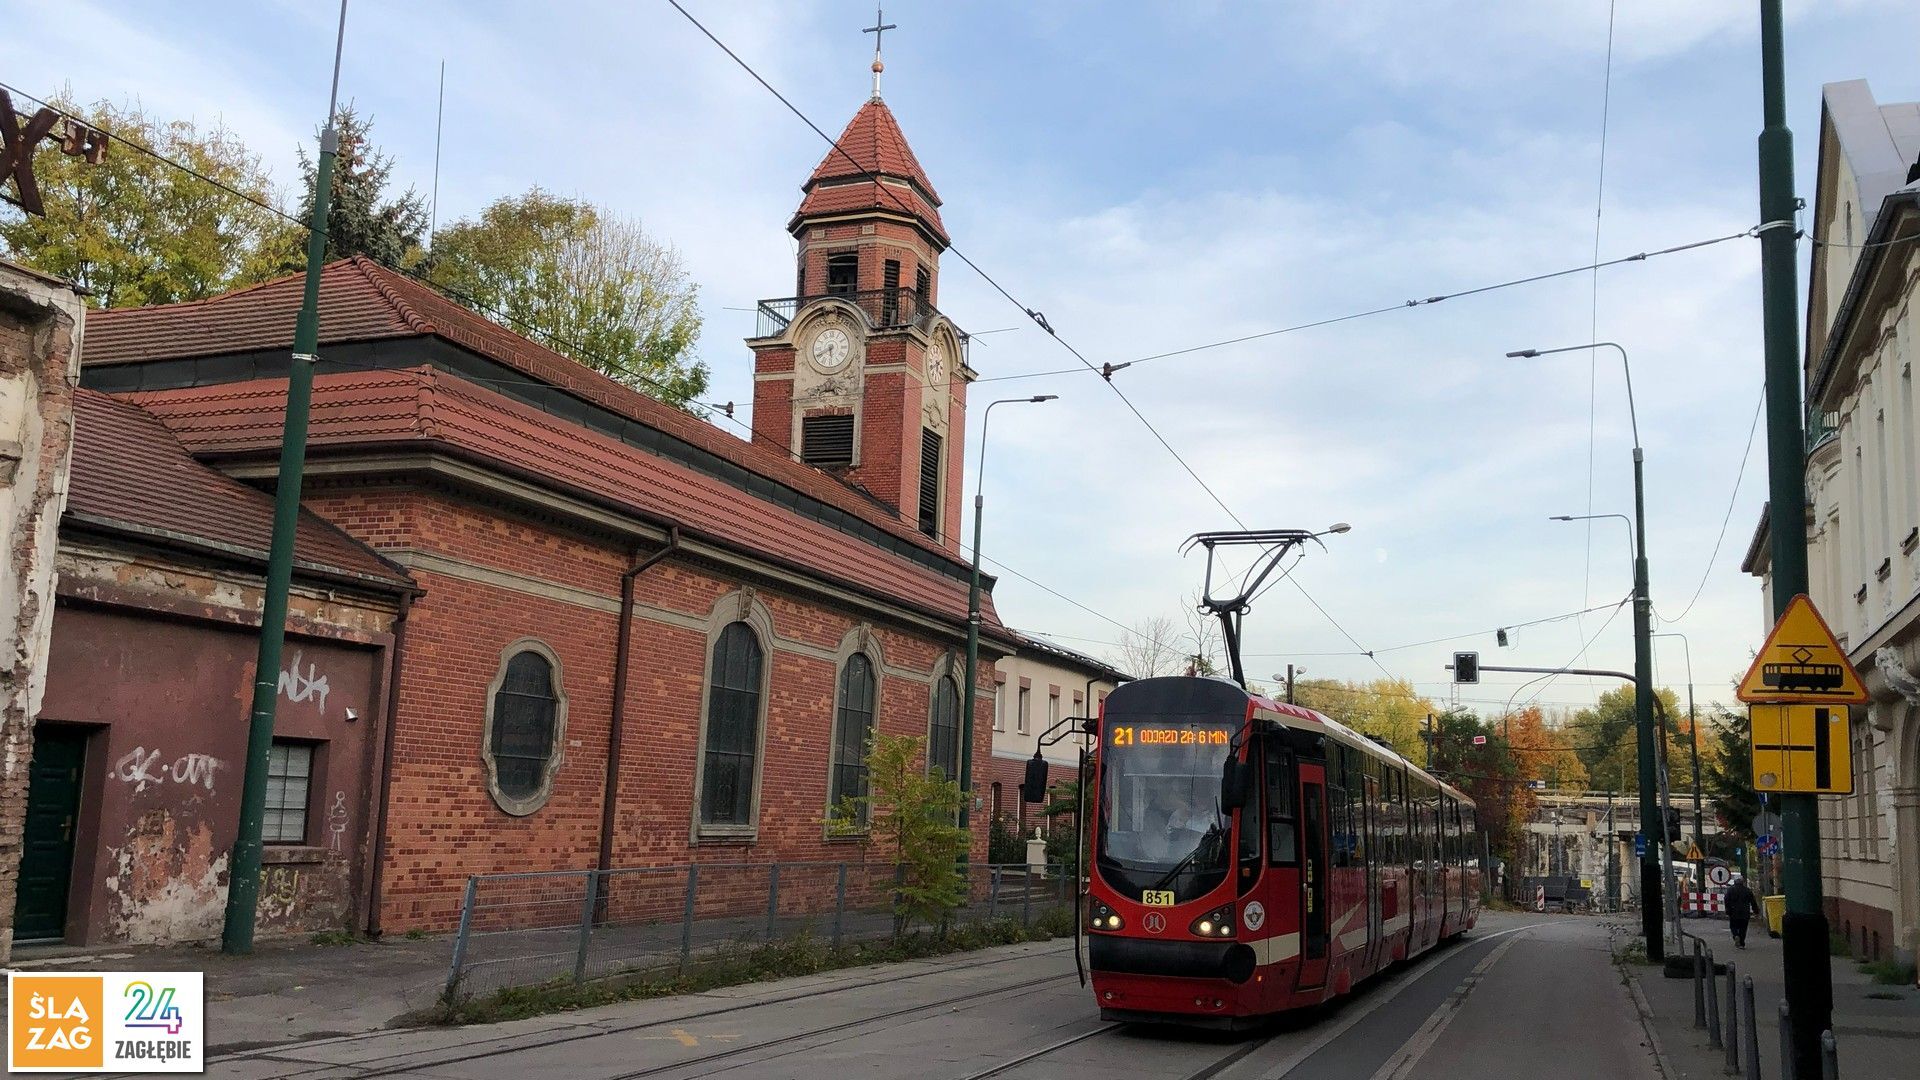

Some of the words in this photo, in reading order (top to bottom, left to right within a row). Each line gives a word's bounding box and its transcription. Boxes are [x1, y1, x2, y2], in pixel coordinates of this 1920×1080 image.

[1114, 727, 1133, 745] 21
[1140, 729, 1178, 744] ODJAZD
[1199, 730, 1206, 744] 6
[1208, 730, 1228, 744] MIN
[1145, 892, 1170, 905] 851
